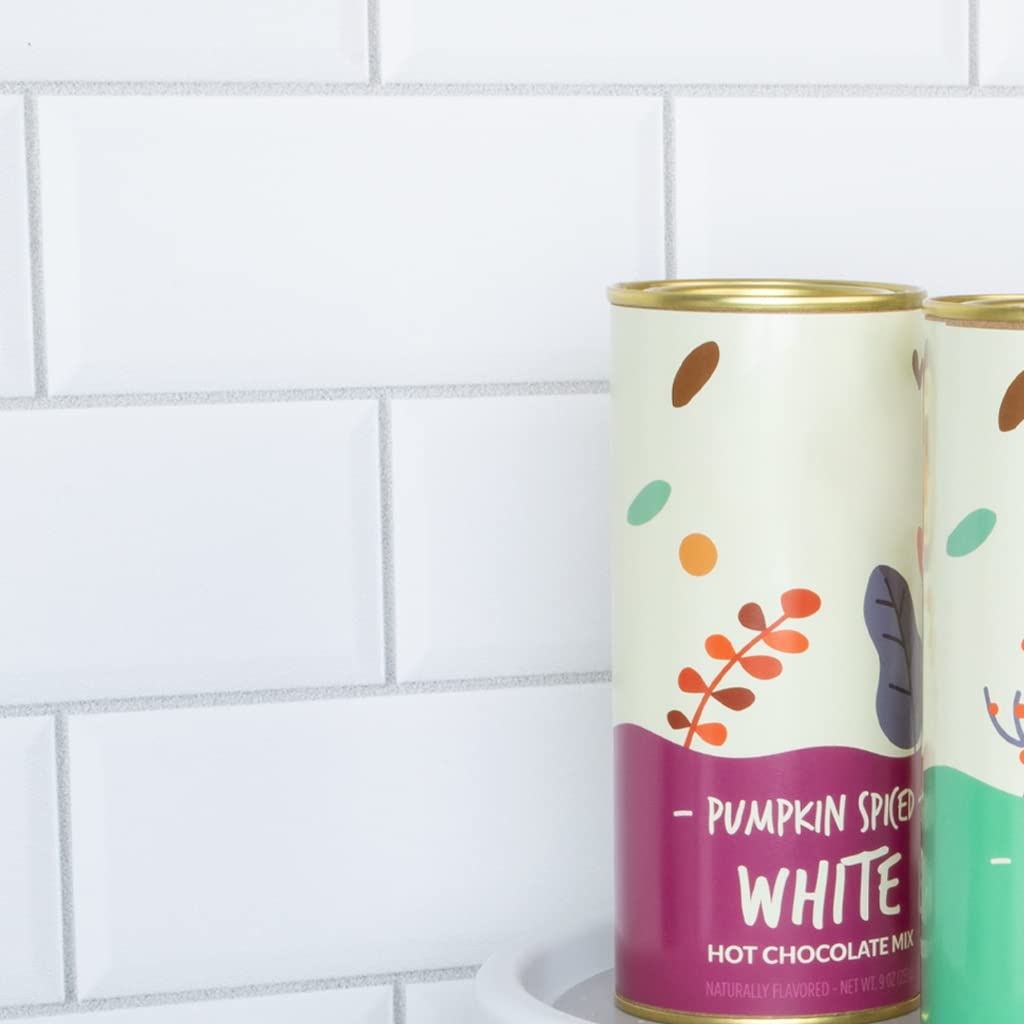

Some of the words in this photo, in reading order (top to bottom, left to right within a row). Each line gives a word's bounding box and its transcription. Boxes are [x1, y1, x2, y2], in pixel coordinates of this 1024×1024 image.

[707, 794, 846, 836] PUMPKIN
[858, 786, 914, 833] SPICED
[738, 846, 901, 929] WHITE
[708, 944, 758, 964] HOT
[762, 937, 889, 965] CHOCOLATE
[892, 929, 914, 953] MIX
[706, 981, 770, 999] NATURALLY
[772, 982, 830, 998] FLAVORED
[840, 978, 859, 996] NET
